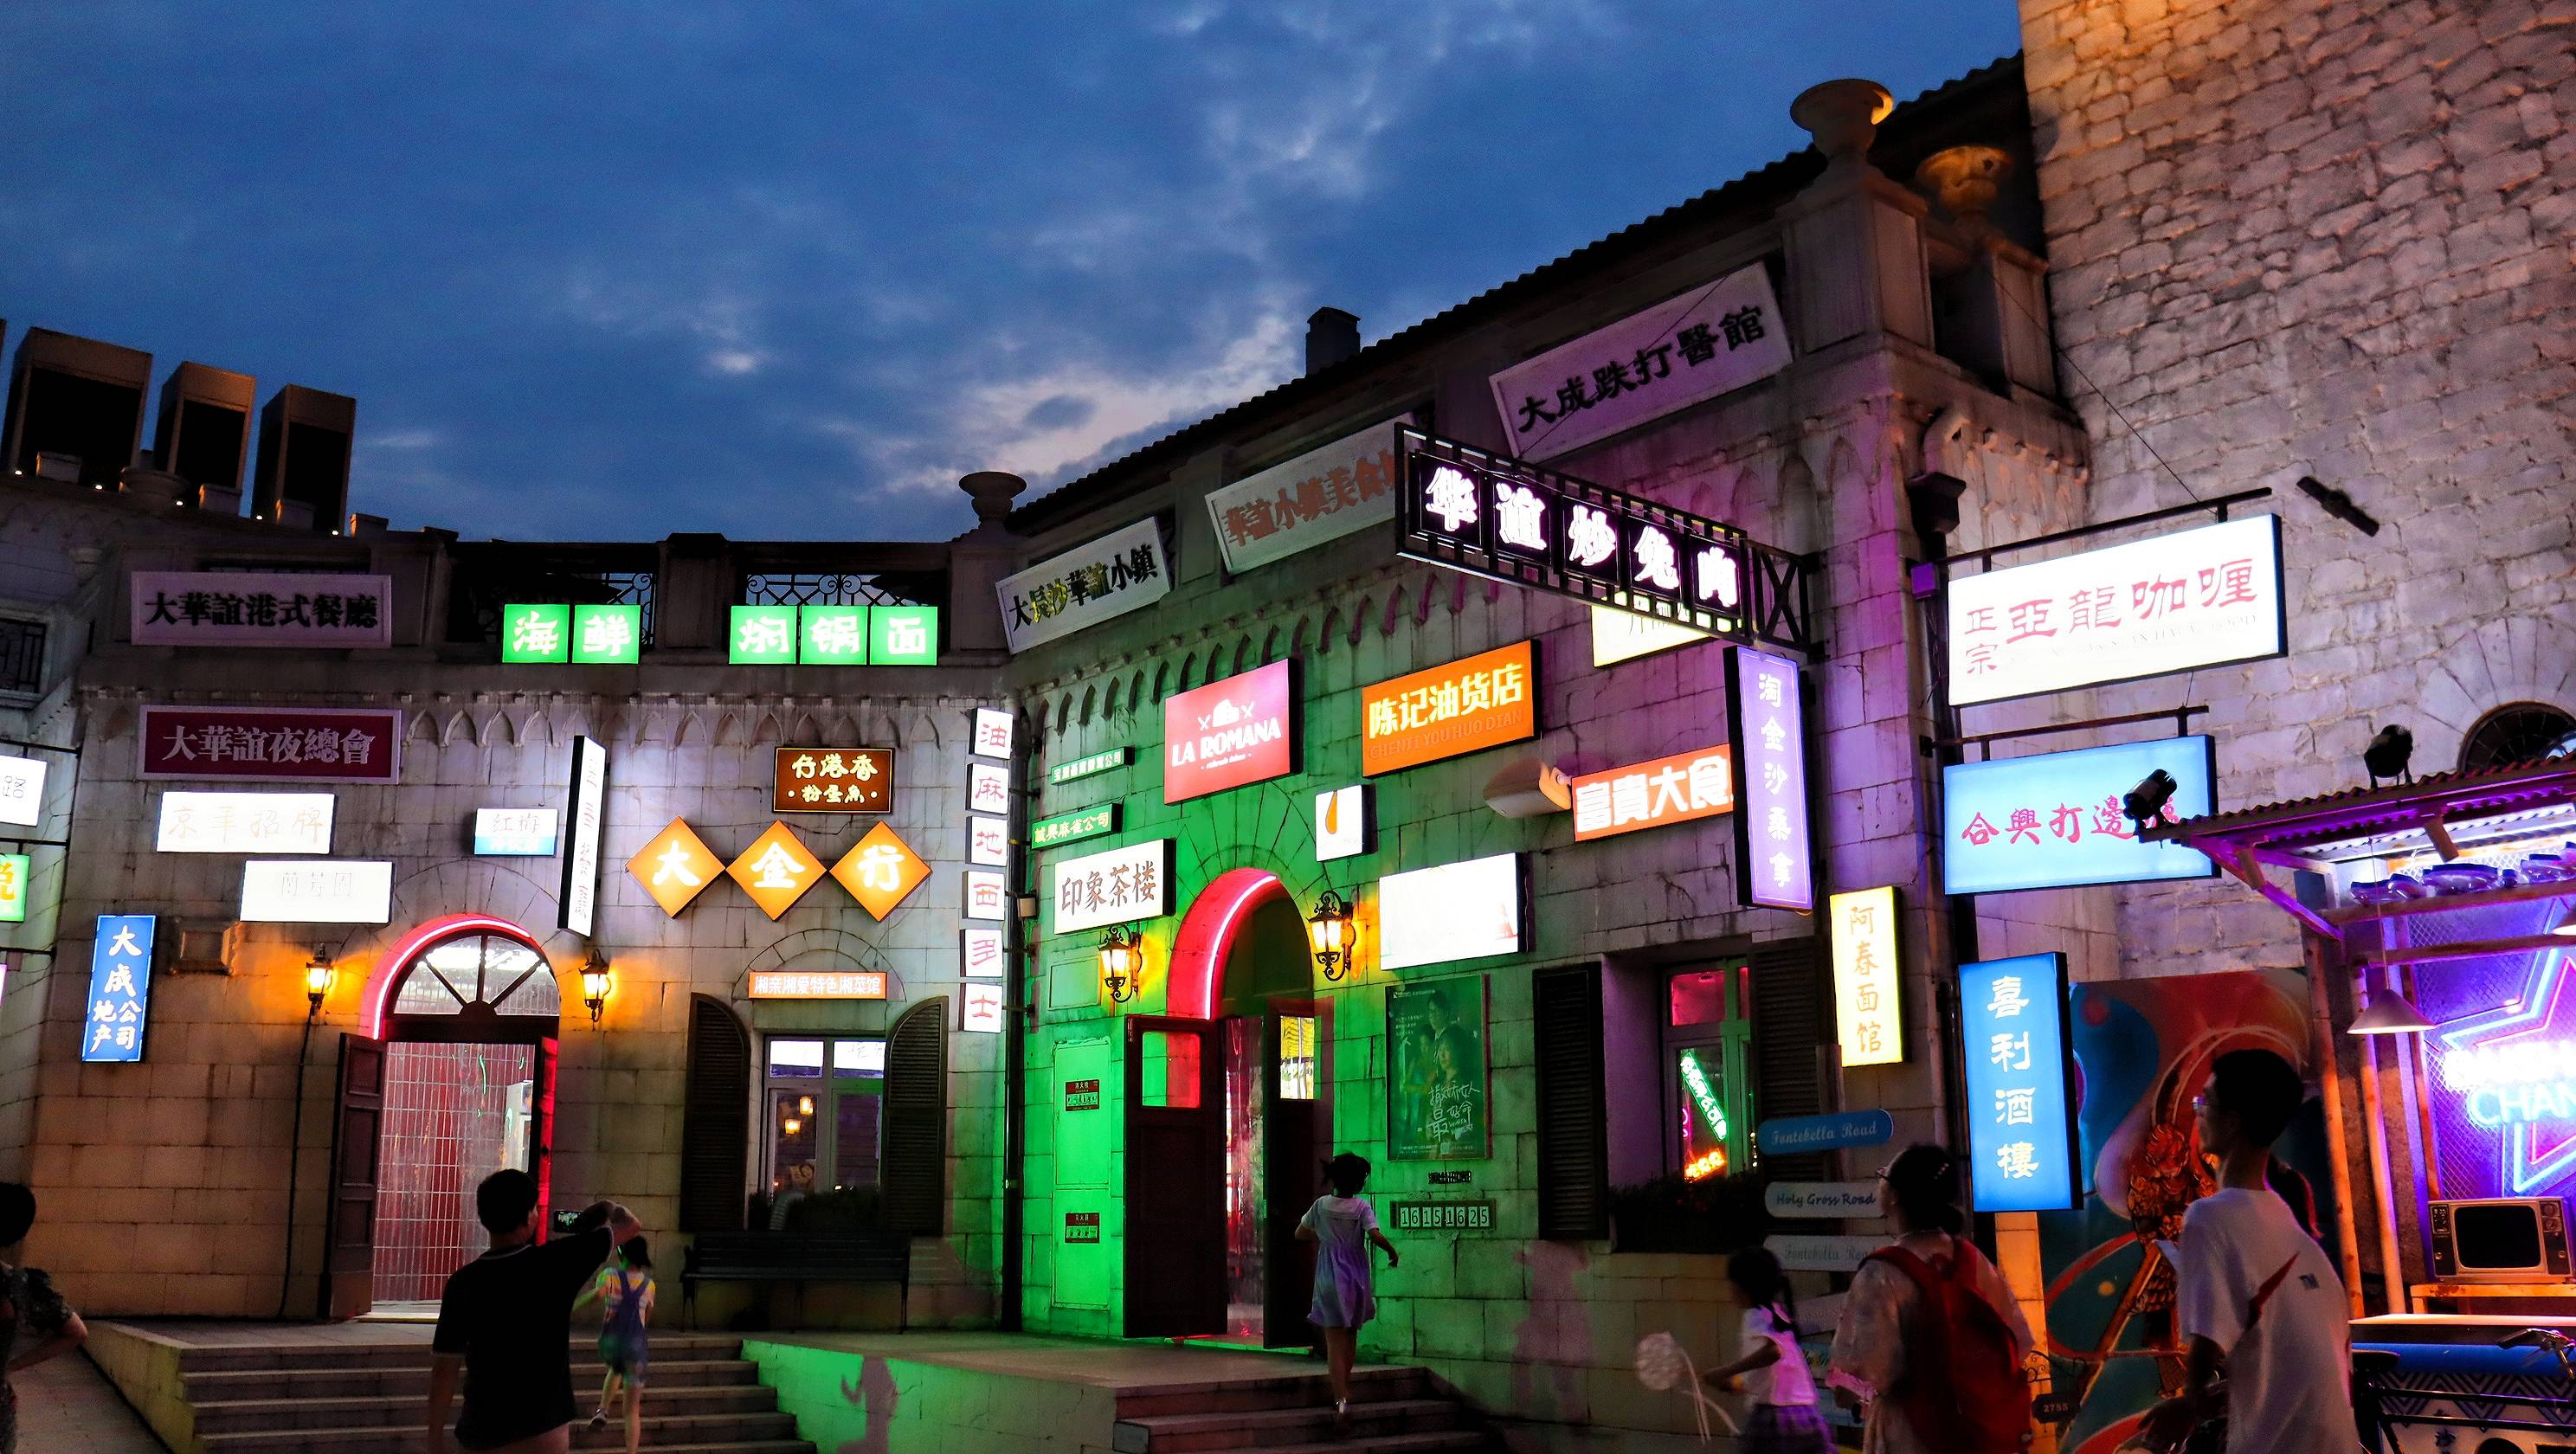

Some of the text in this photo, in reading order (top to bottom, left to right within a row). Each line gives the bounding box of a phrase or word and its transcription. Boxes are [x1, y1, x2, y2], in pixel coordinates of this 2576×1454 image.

[1517, 306, 1766, 433] 大成跌打醫館
[145, 591, 378, 628] 大華誼港式餐廳
[512, 611, 633, 656] 海鲜
[1964, 607, 1998, 674] 正宗
[1368, 663, 1523, 739] 陈记油货店
[162, 724, 376, 764] 大華誼夜總會
[1172, 741, 1195, 767] LA
[1200, 717, 1281, 760] ROMANA
[1423, 730, 1451, 748] YOU
[652, 840, 905, 891] 大金行
[969, 722, 1007, 1019] 油麻地西多士
[1060, 859, 1156, 918] 印象茶楼
[1849, 905, 1883, 1054] 阿春面馆
[1987, 975, 2039, 1181] 喜利酒樓
[1842, 1121, 1878, 1139] Road
[1776, 1193, 1804, 1207] Holy
[1842, 1193, 1877, 1206] Road
[1845, 1246, 1875, 1261] Roa
